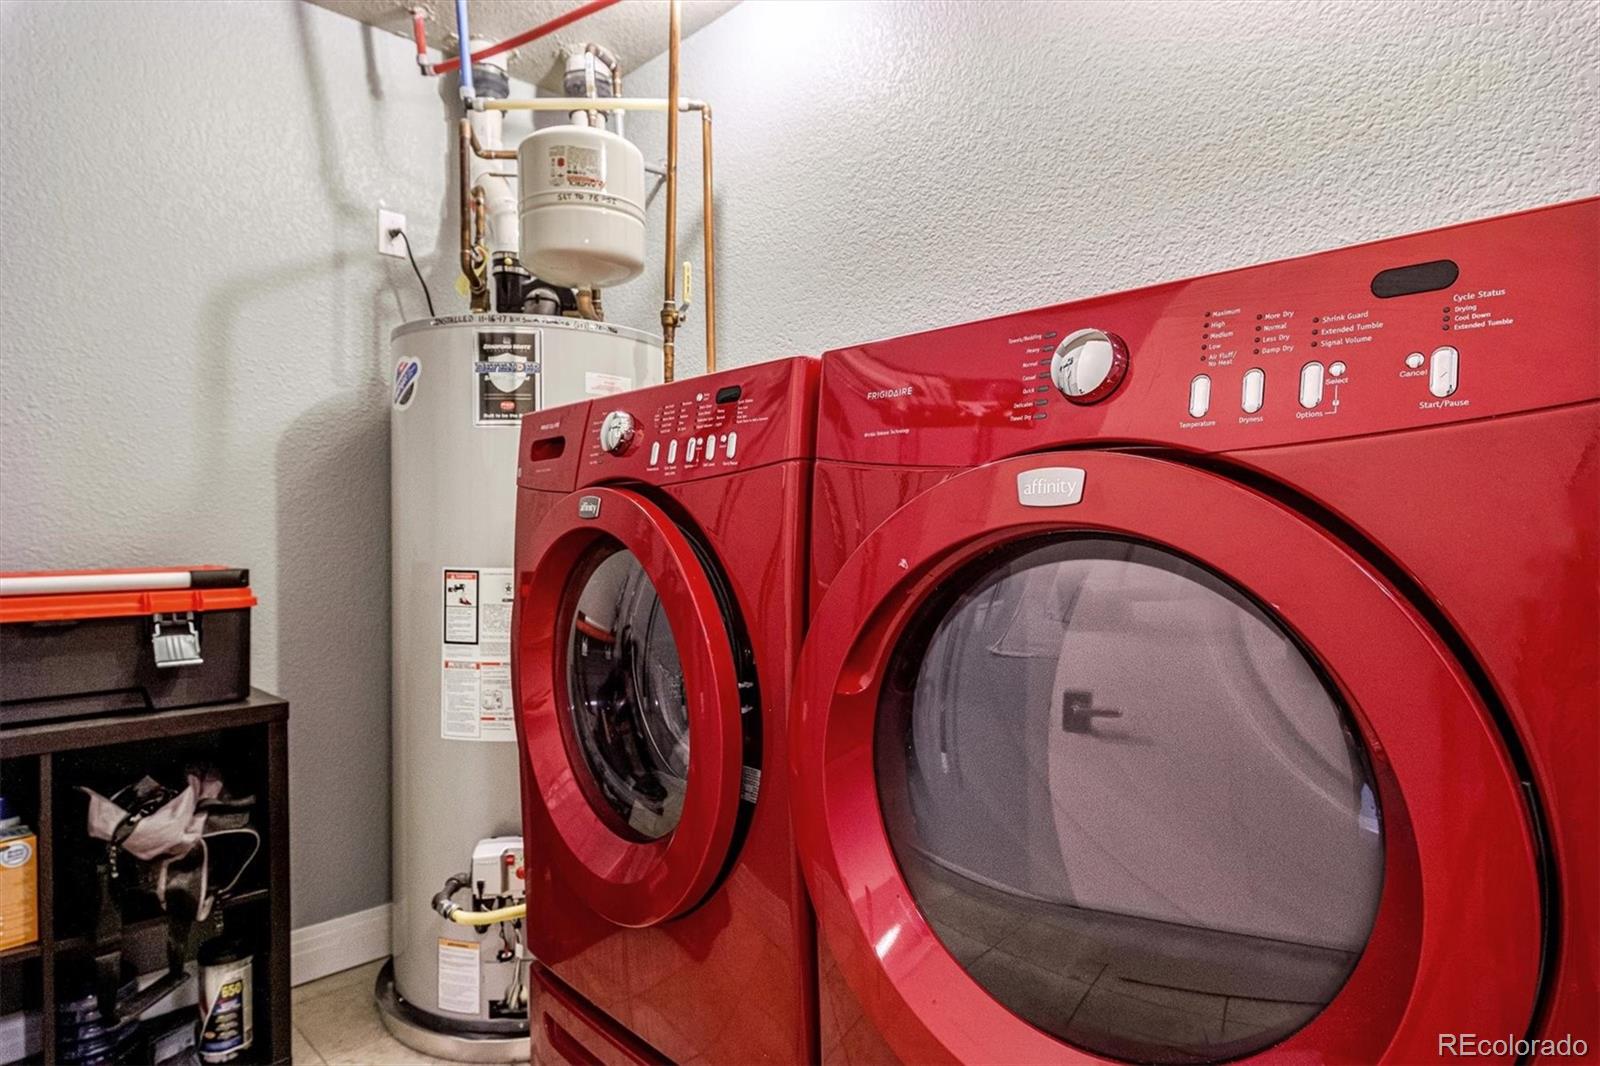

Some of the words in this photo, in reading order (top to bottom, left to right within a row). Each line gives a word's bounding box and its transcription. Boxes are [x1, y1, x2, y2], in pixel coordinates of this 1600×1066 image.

[1454, 292, 1476, 302] Cycle
[1478, 288, 1506, 298] Status
[1212, 308, 1241, 318] Maximum
[1455, 304, 1477, 312] Drying
[1264, 312, 1281, 320] More
[1282, 310, 1295, 319] Dry
[1322, 314, 1345, 324] Shrink
[1347, 311, 1369, 321] Guard
[1211, 321, 1226, 329] High
[1264, 323, 1287, 331] Normal
[1321, 325, 1354, 335] Extended
[1357, 322, 1384, 332] Tumble
[1454, 321, 1485, 330] Extended
[1488, 318, 1513, 327] Tumble
[1210, 331, 1234, 339] Medium
[1278, 334, 1290, 343] Dry
[1321, 338, 1343, 348] Signal
[1345, 335, 1373, 344] Volume
[1262, 346, 1280, 355] Damp
[1282, 344, 1295, 353] Dry
[1400, 369, 1428, 378] Cancel
[1325, 376, 1349, 385] Select
[867, 386, 913, 400] FRIGIDAIRE
[1419, 399, 1470, 409] Start/Pause
[1239, 416, 1264, 424] Dryness
[1296, 411, 1324, 420] Options
[1179, 420, 1216, 429] Temperature
[1023, 477, 1077, 496] affinity
